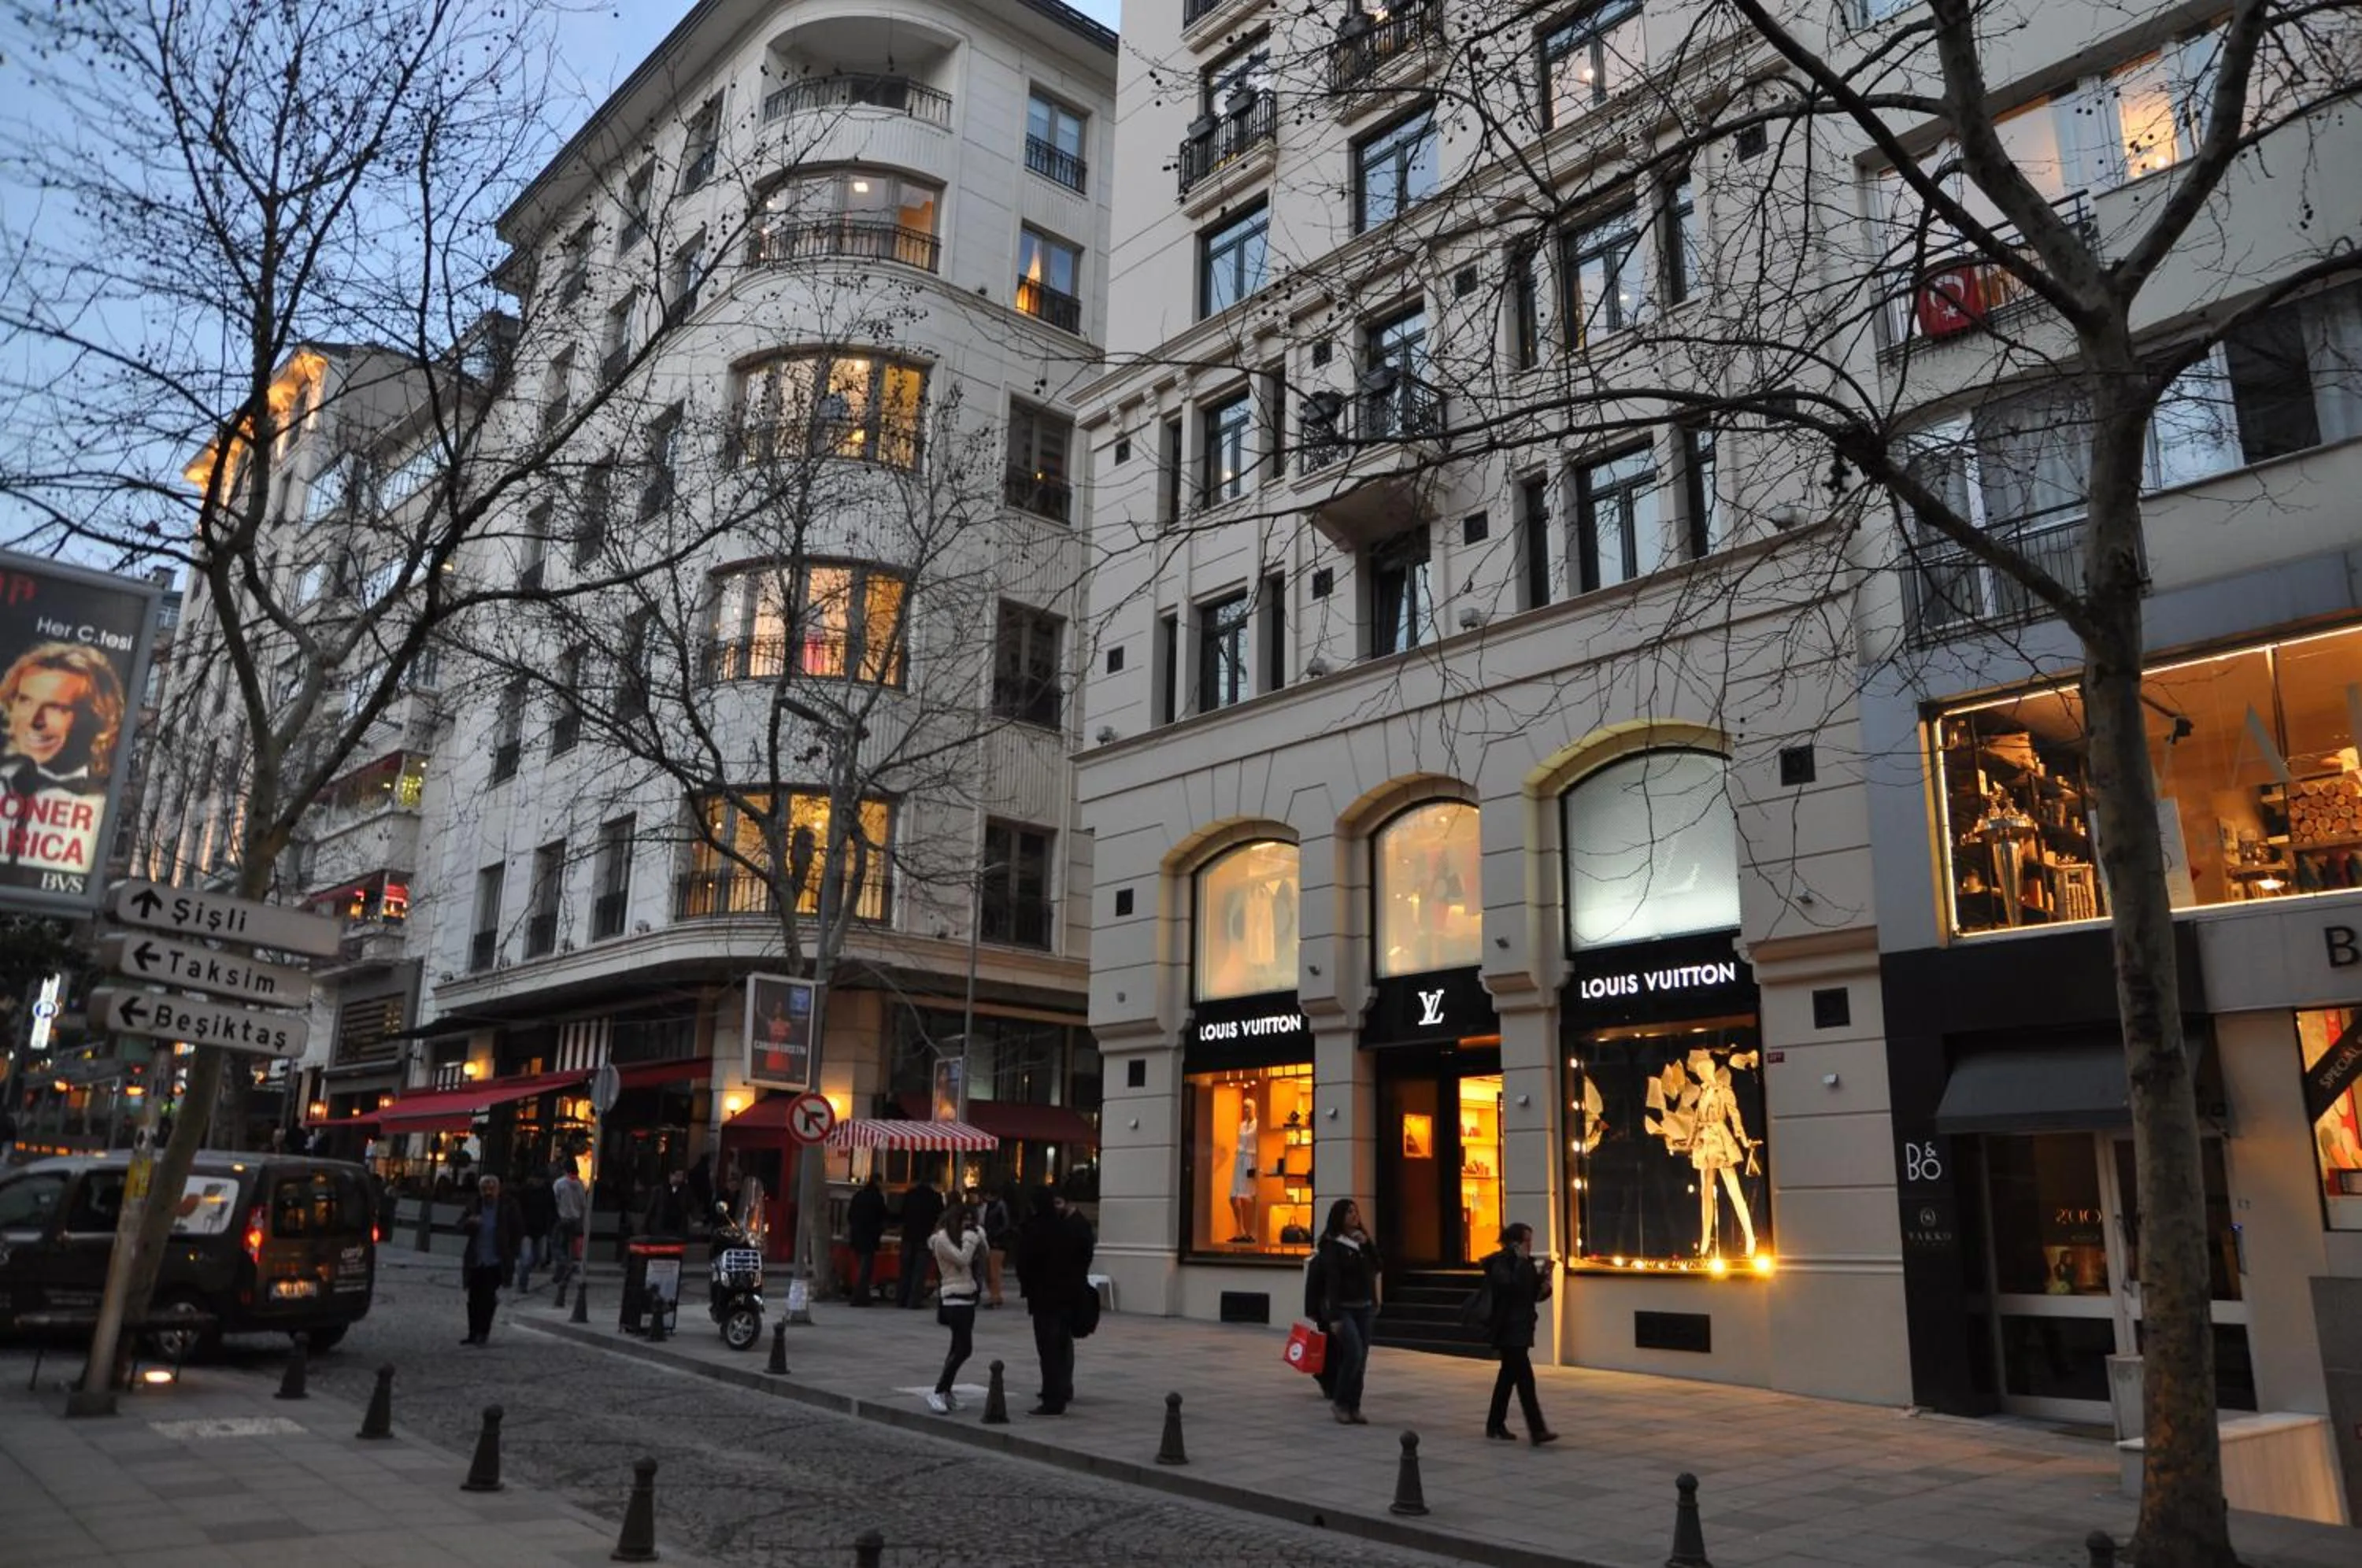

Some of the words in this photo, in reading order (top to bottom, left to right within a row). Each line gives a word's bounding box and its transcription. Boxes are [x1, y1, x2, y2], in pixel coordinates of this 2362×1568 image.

[36, 616, 72, 638] Her
[0, 827, 83, 865] RICA
[172, 898, 247, 932] Şişli
[168, 949, 276, 994] Taksim
[1581, 973, 1638, 1000] LOUIS
[1643, 962, 1736, 992] VUITTON
[154, 1004, 287, 1052] Beşiktaş
[1199, 1020, 1238, 1041] LOUIS
[1241, 1014, 1302, 1037] VUITTON
